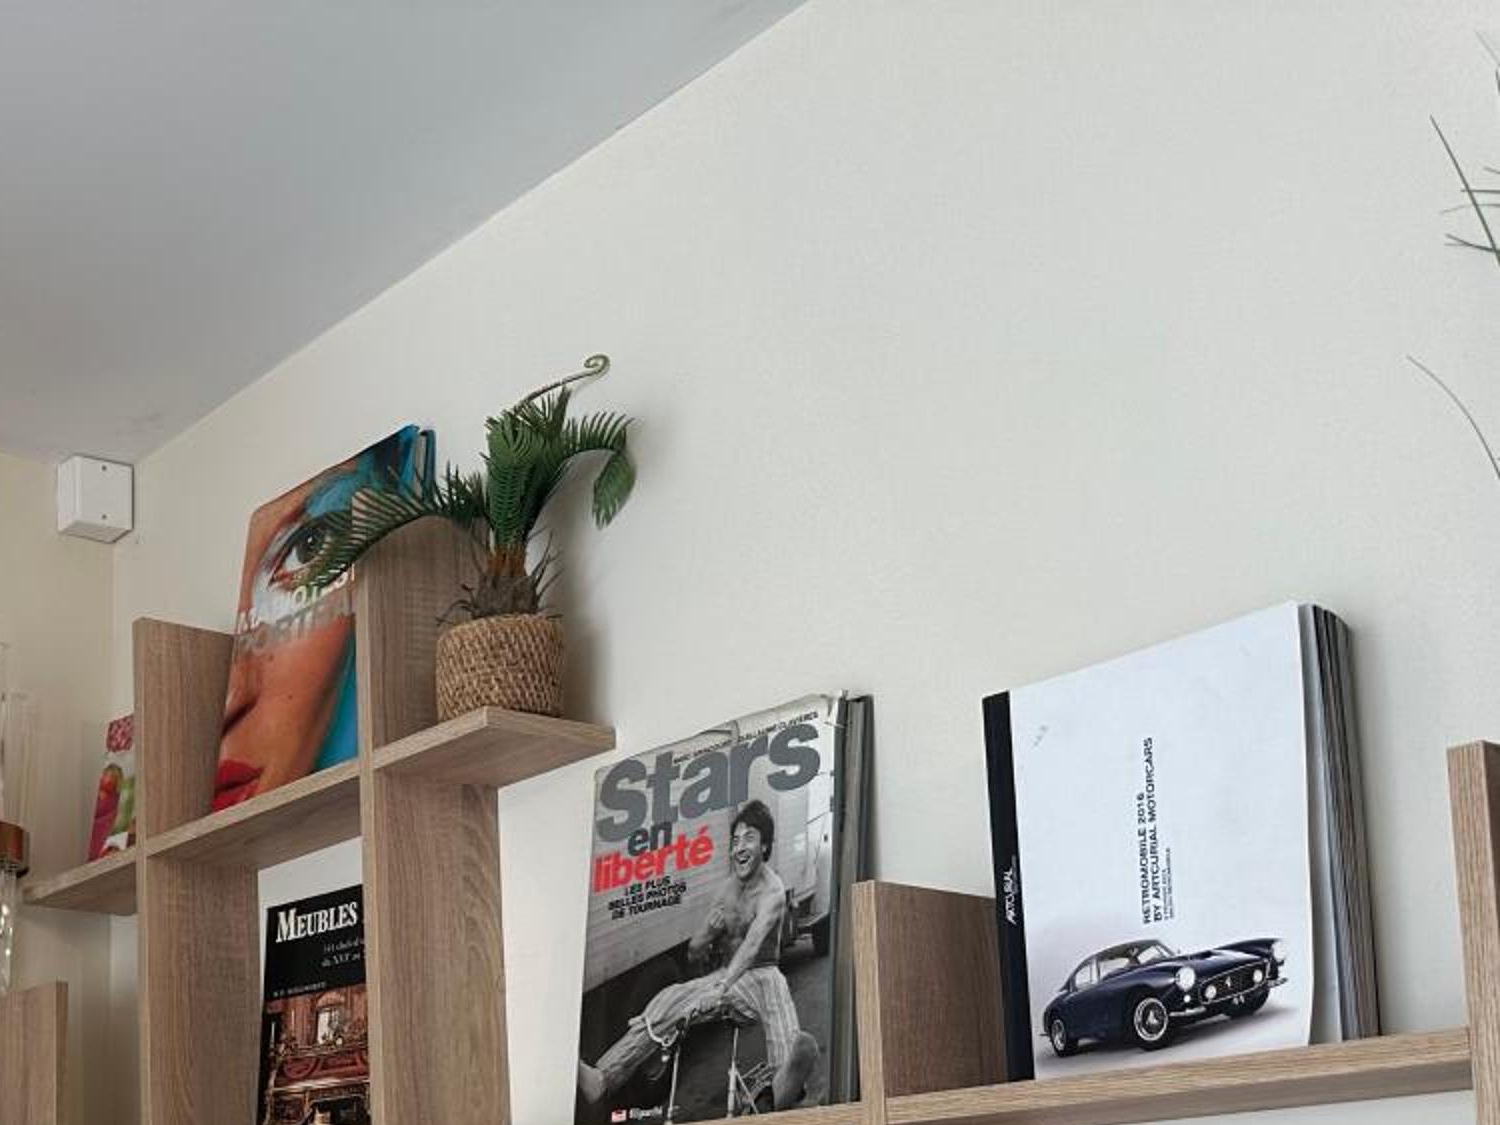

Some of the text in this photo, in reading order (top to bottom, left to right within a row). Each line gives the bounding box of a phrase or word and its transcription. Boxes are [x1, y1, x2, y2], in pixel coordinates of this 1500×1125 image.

[595, 723, 821, 842] Stars
[627, 821, 673, 856] en
[1142, 737, 1163, 922] BY ARTCURIAL MOTORCARS
[592, 824, 715, 893] liberté
[1136, 792, 1152, 925] RETROMOBILE 2016
[608, 881, 687, 911] BELLES PHOTOS
[624, 875, 671, 897] LES PLUS
[276, 901, 358, 943] MEUBLES
[611, 895, 682, 920] DE TOURNAGE
